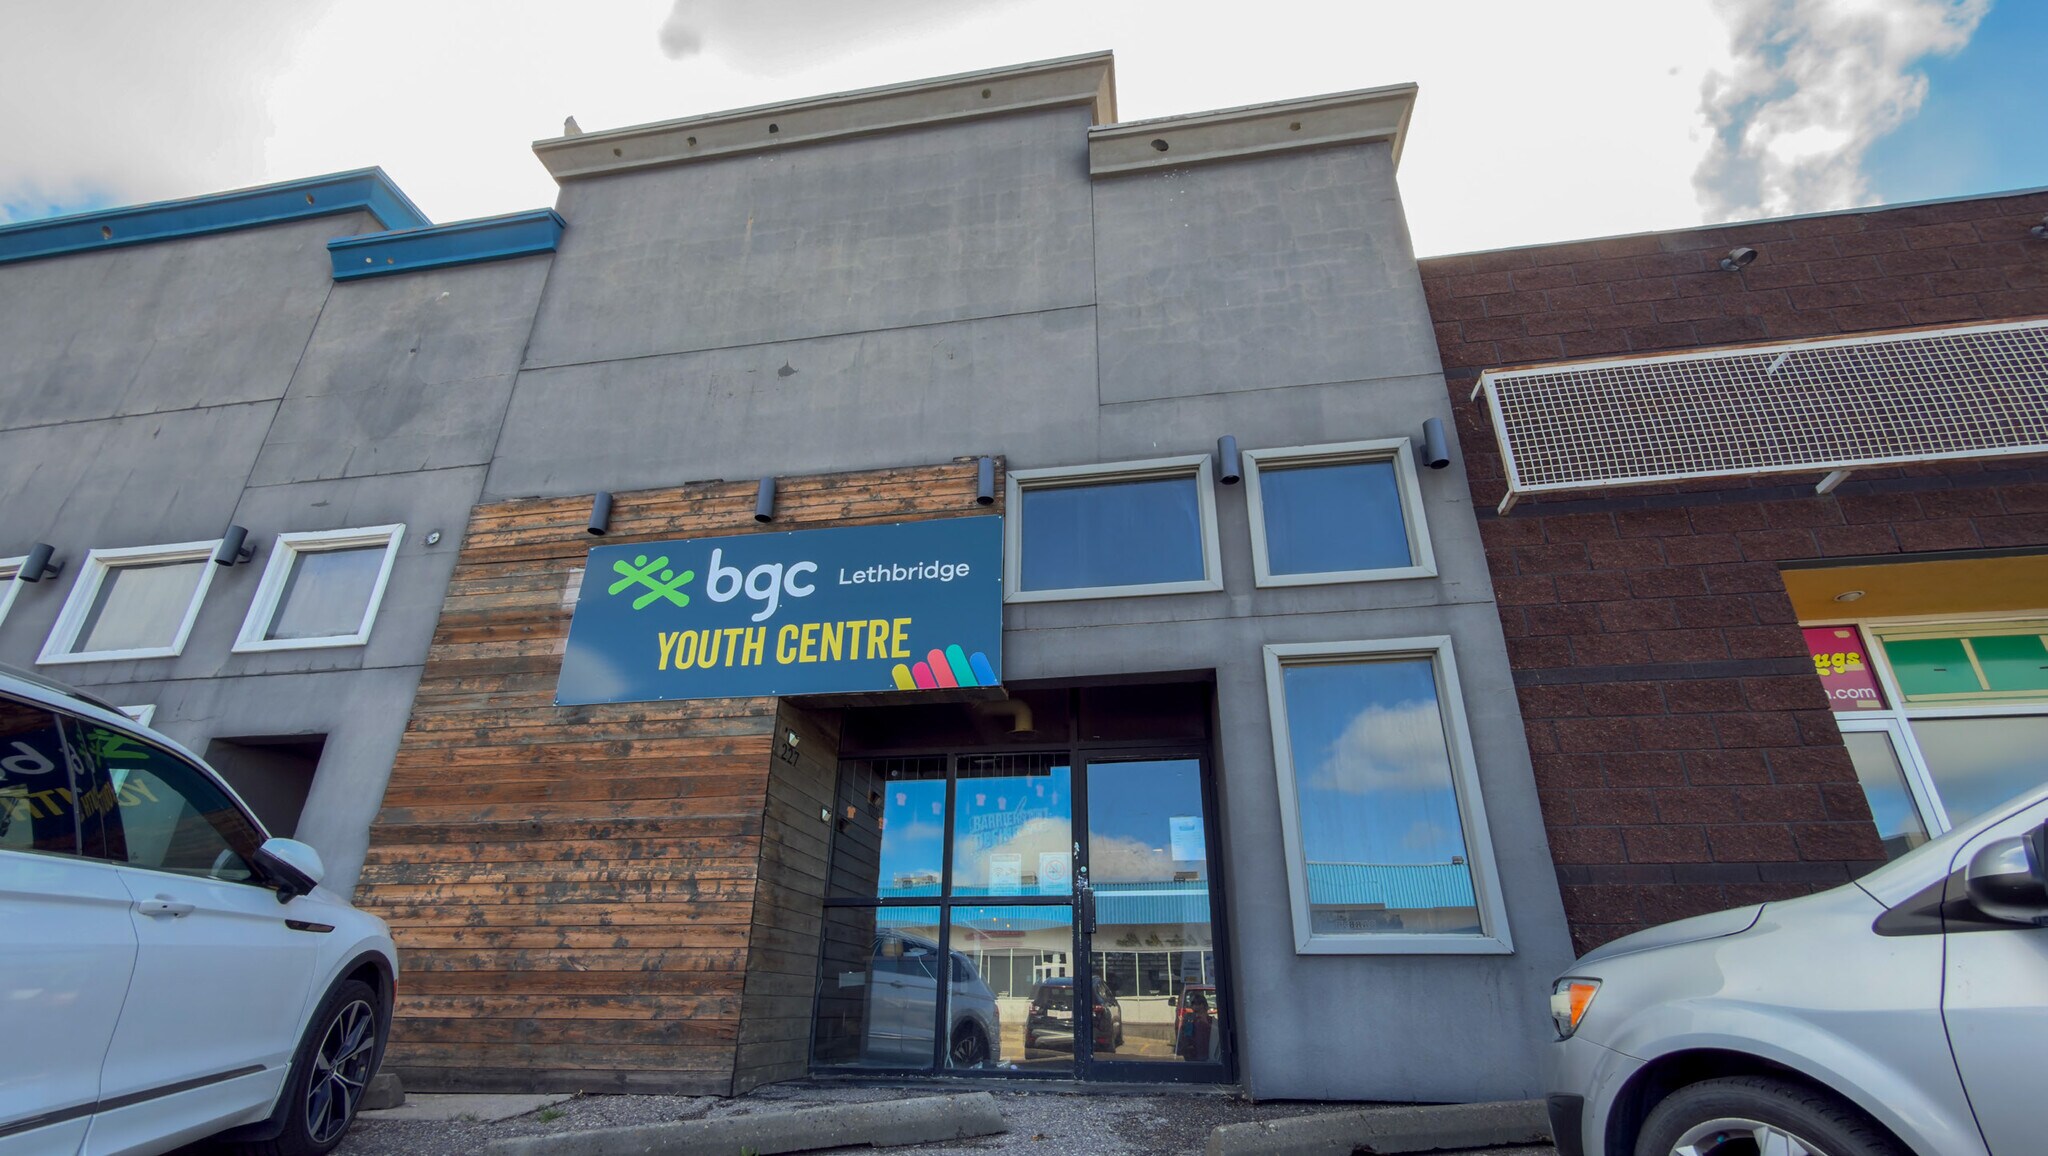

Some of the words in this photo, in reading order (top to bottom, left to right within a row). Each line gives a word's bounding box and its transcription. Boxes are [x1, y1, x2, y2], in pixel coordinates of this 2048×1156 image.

[706, 548, 818, 622] bgc
[839, 560, 970, 585] Lethbridge
[658, 626, 766, 671] YOUTH
[776, 617, 912, 665] CENTRE
[1813, 652, 1861, 676] ugs
[781, 743, 799, 767] 227
